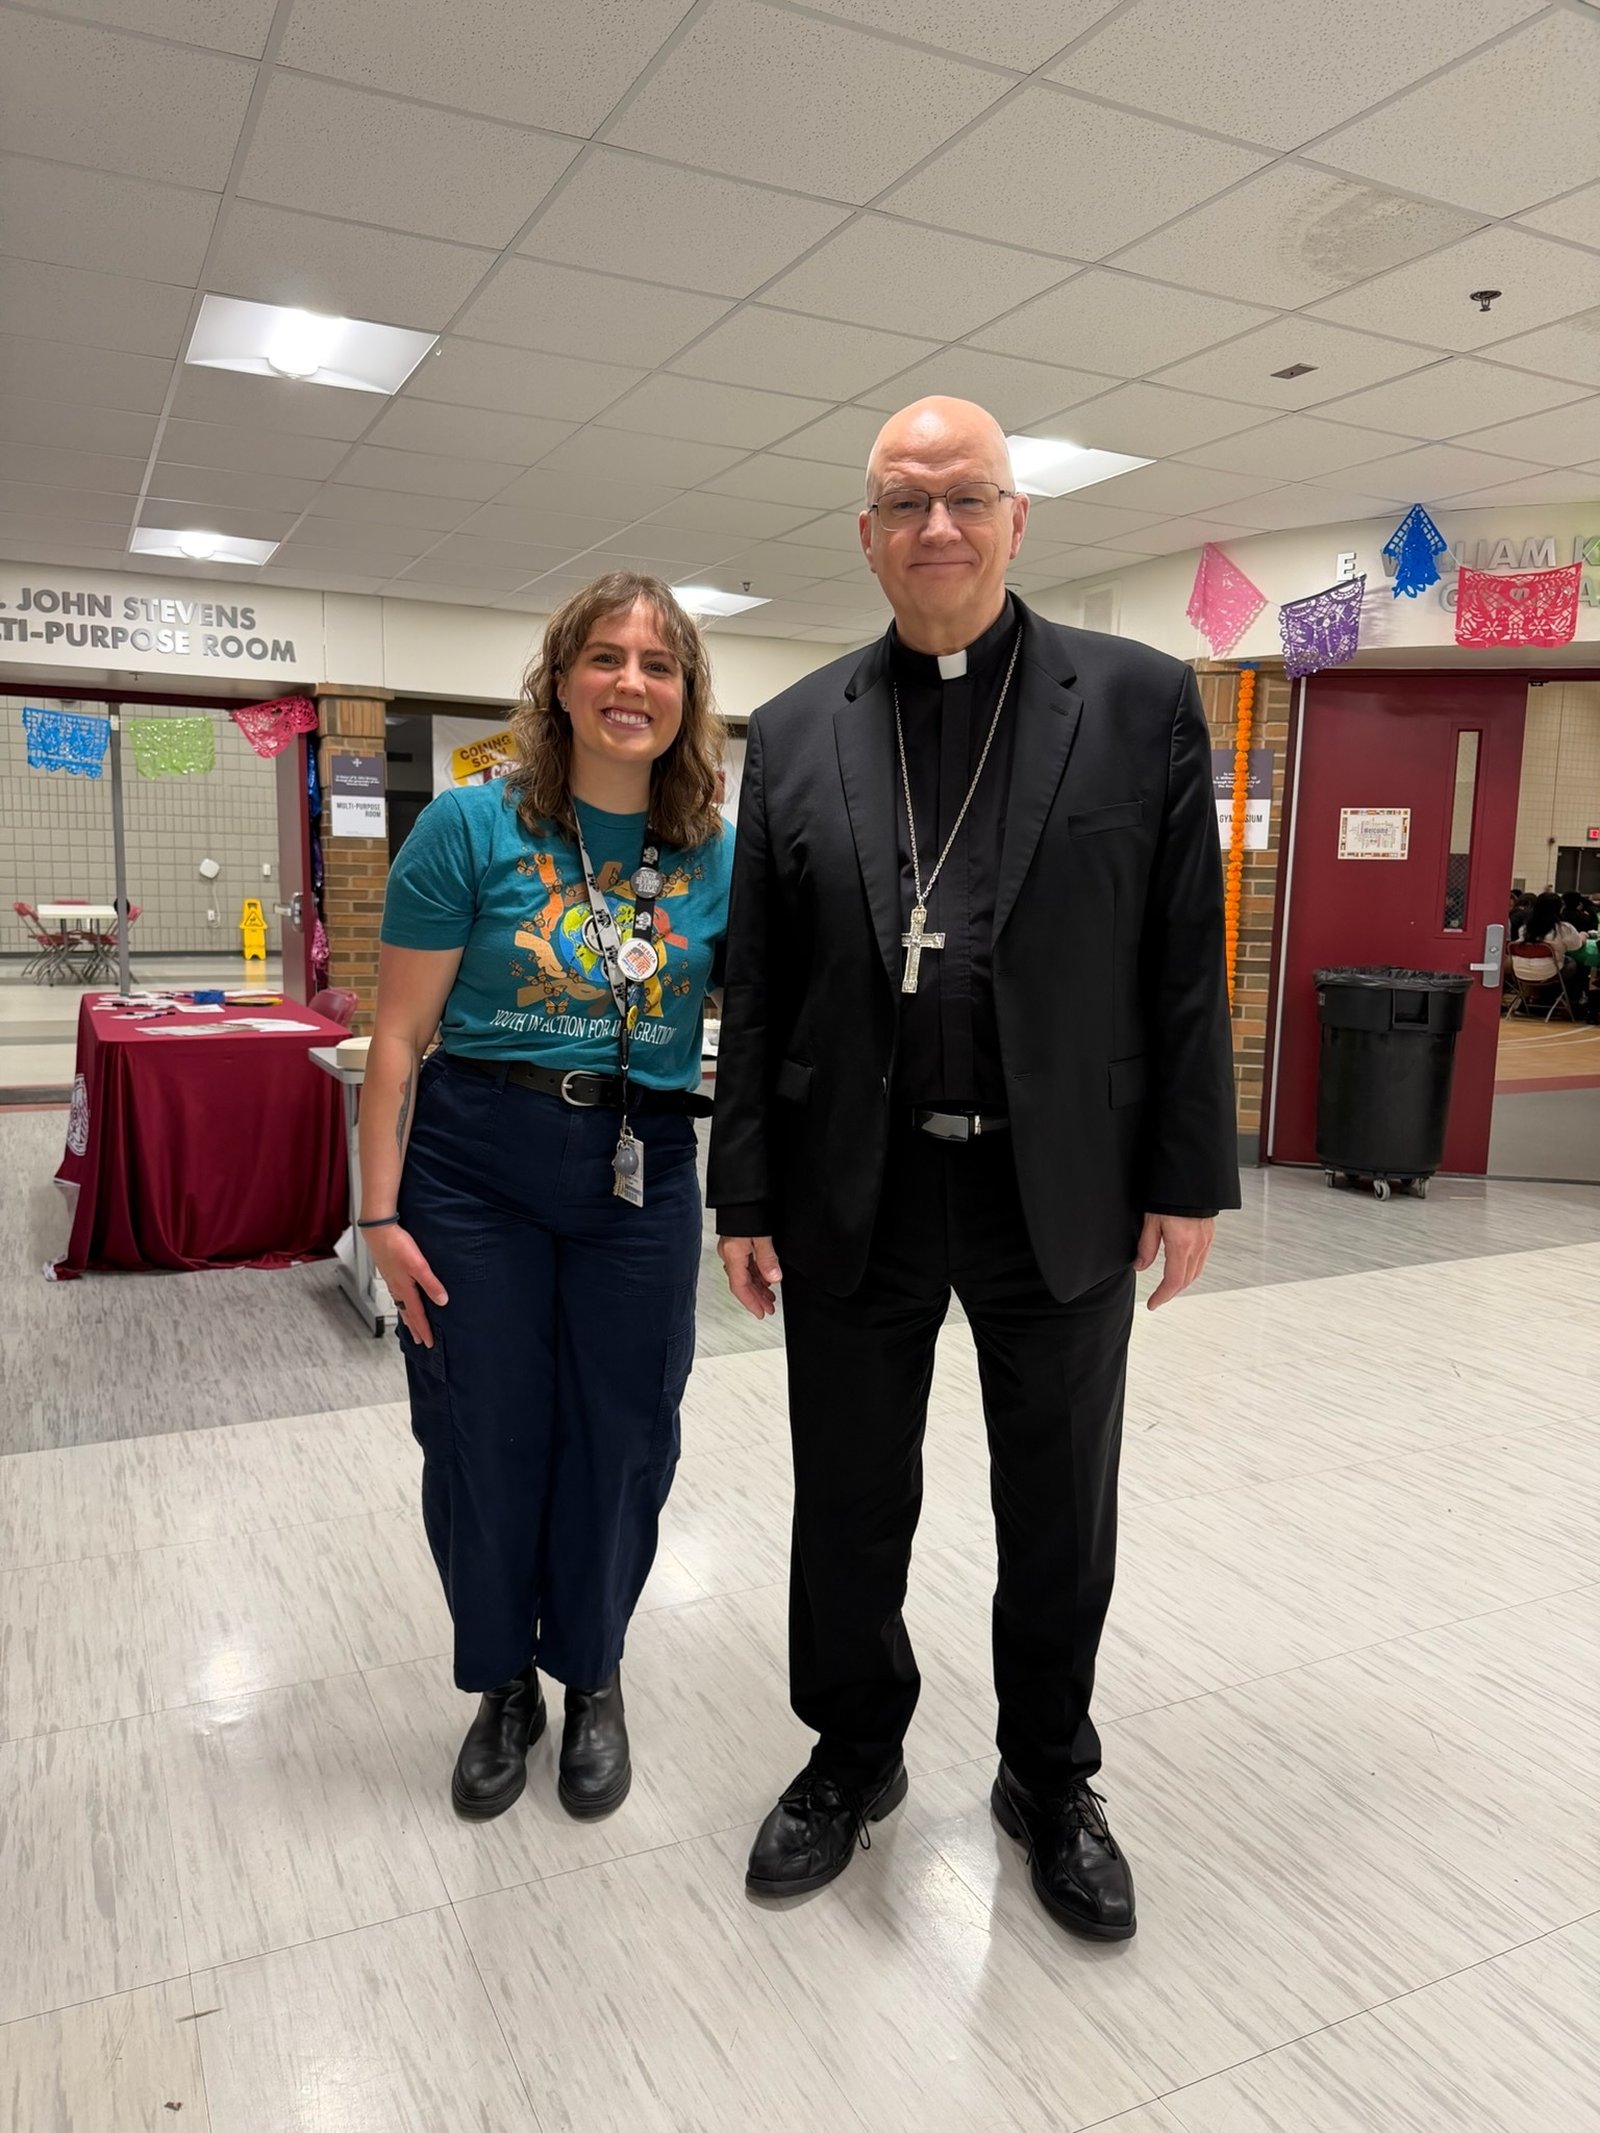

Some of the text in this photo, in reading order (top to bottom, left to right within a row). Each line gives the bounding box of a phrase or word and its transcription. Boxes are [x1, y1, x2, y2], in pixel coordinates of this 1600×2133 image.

[1381, 535, 1556, 578] WLIAM
[16, 587, 257, 631] JOHN STEVENS
[0, 616, 297, 663] TI-PURPOSE ROOM
[460, 735, 512, 760] COMING
[336, 802, 381, 811] MULTI-PURPOSE
[1219, 814, 1263, 824] GYSIUM
[490, 1009, 678, 1046] YOUTH IN ACTION FOR IIGRATIO
